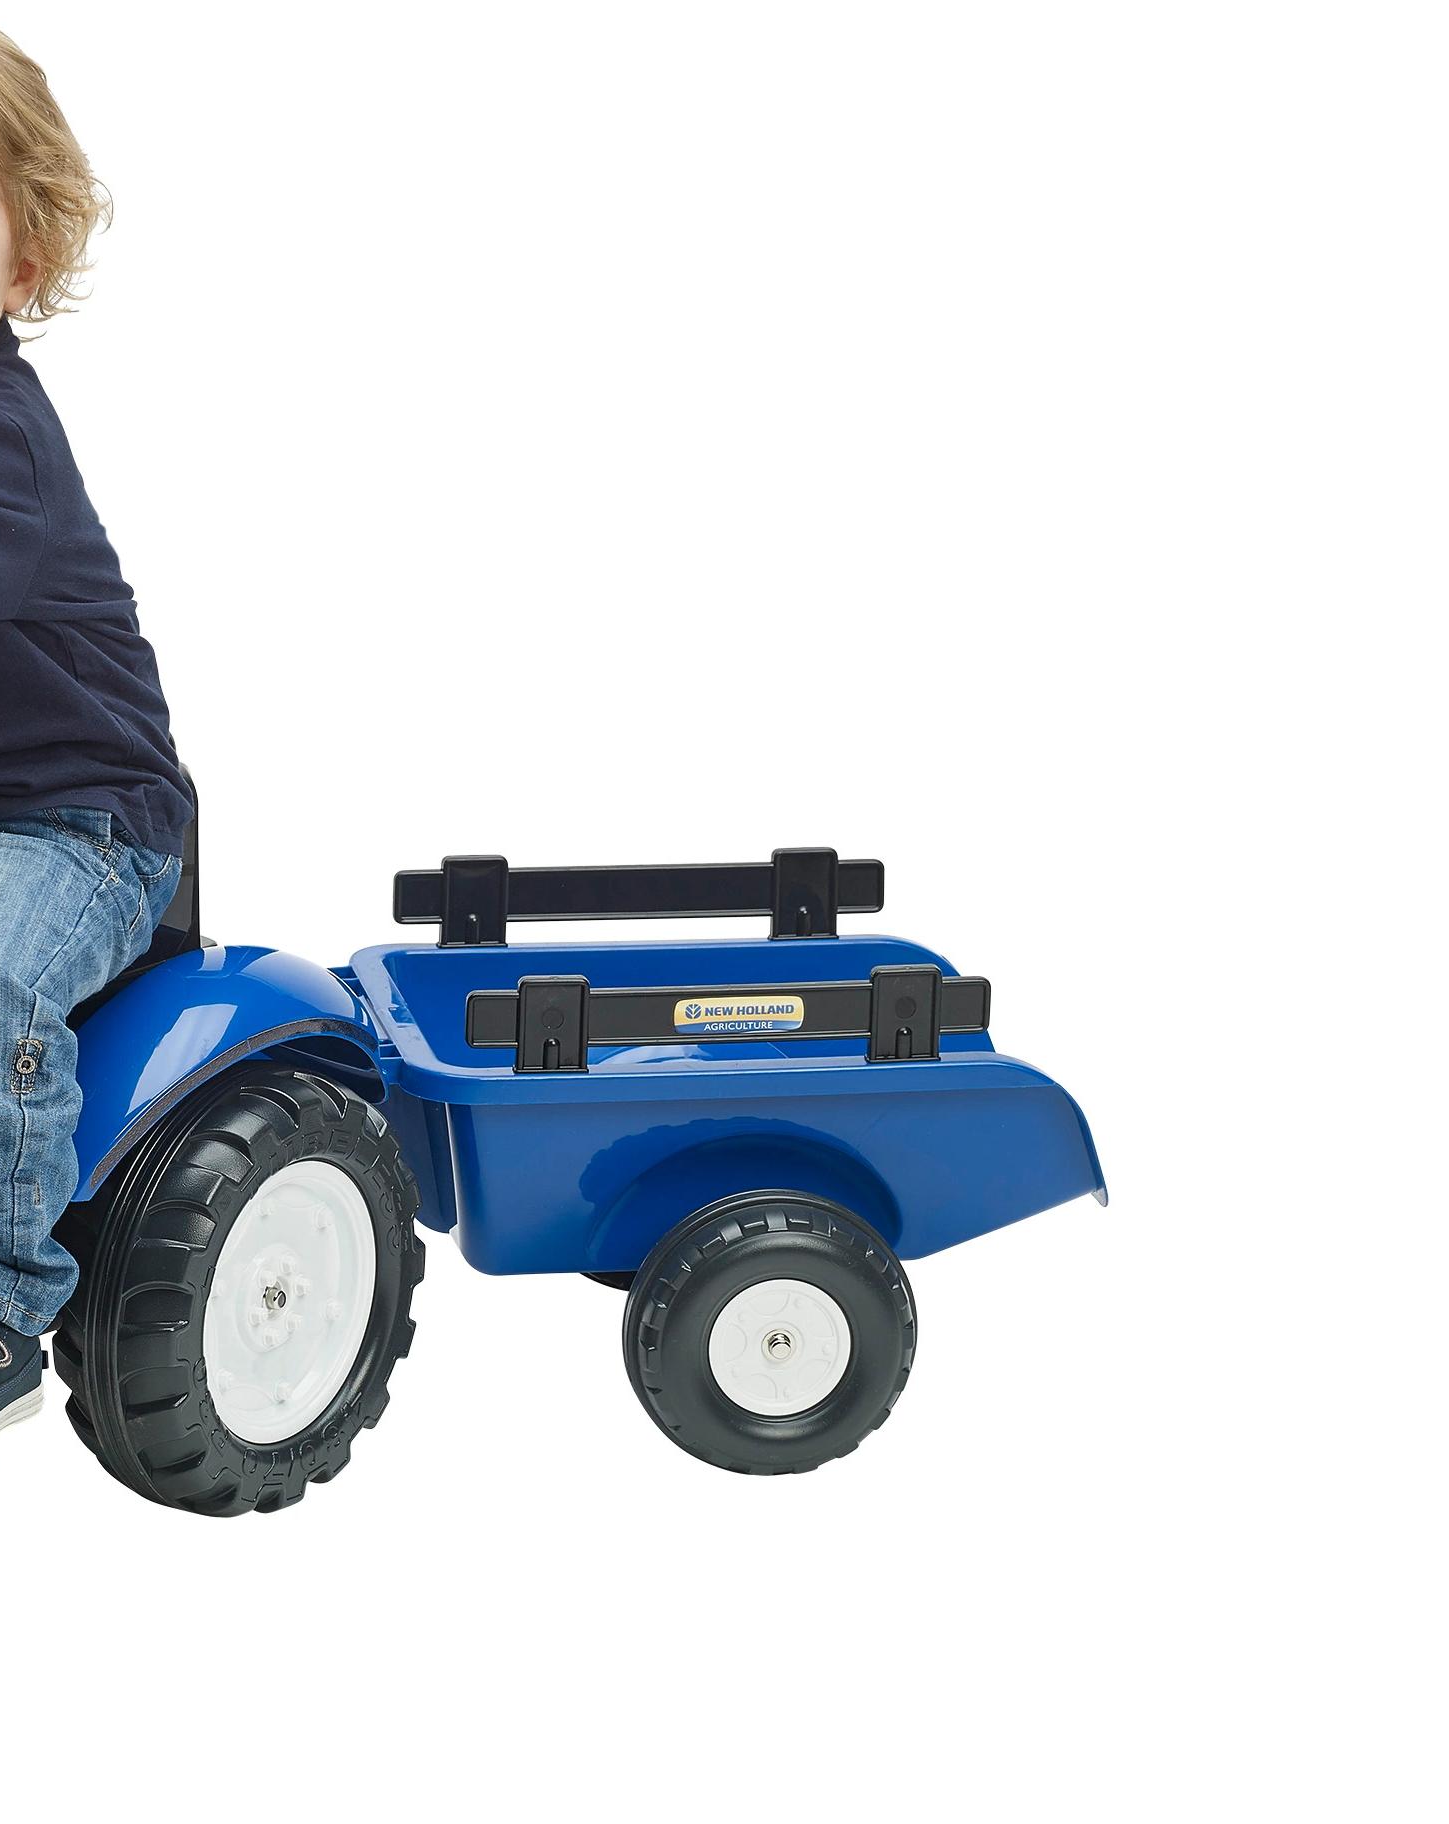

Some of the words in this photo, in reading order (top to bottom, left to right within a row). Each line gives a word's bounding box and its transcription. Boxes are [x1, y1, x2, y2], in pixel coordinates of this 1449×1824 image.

[704, 1007, 734, 1017] NEW
[736, 1004, 795, 1016] HOLLAND
[703, 1021, 774, 1031] AGRICULTURE
